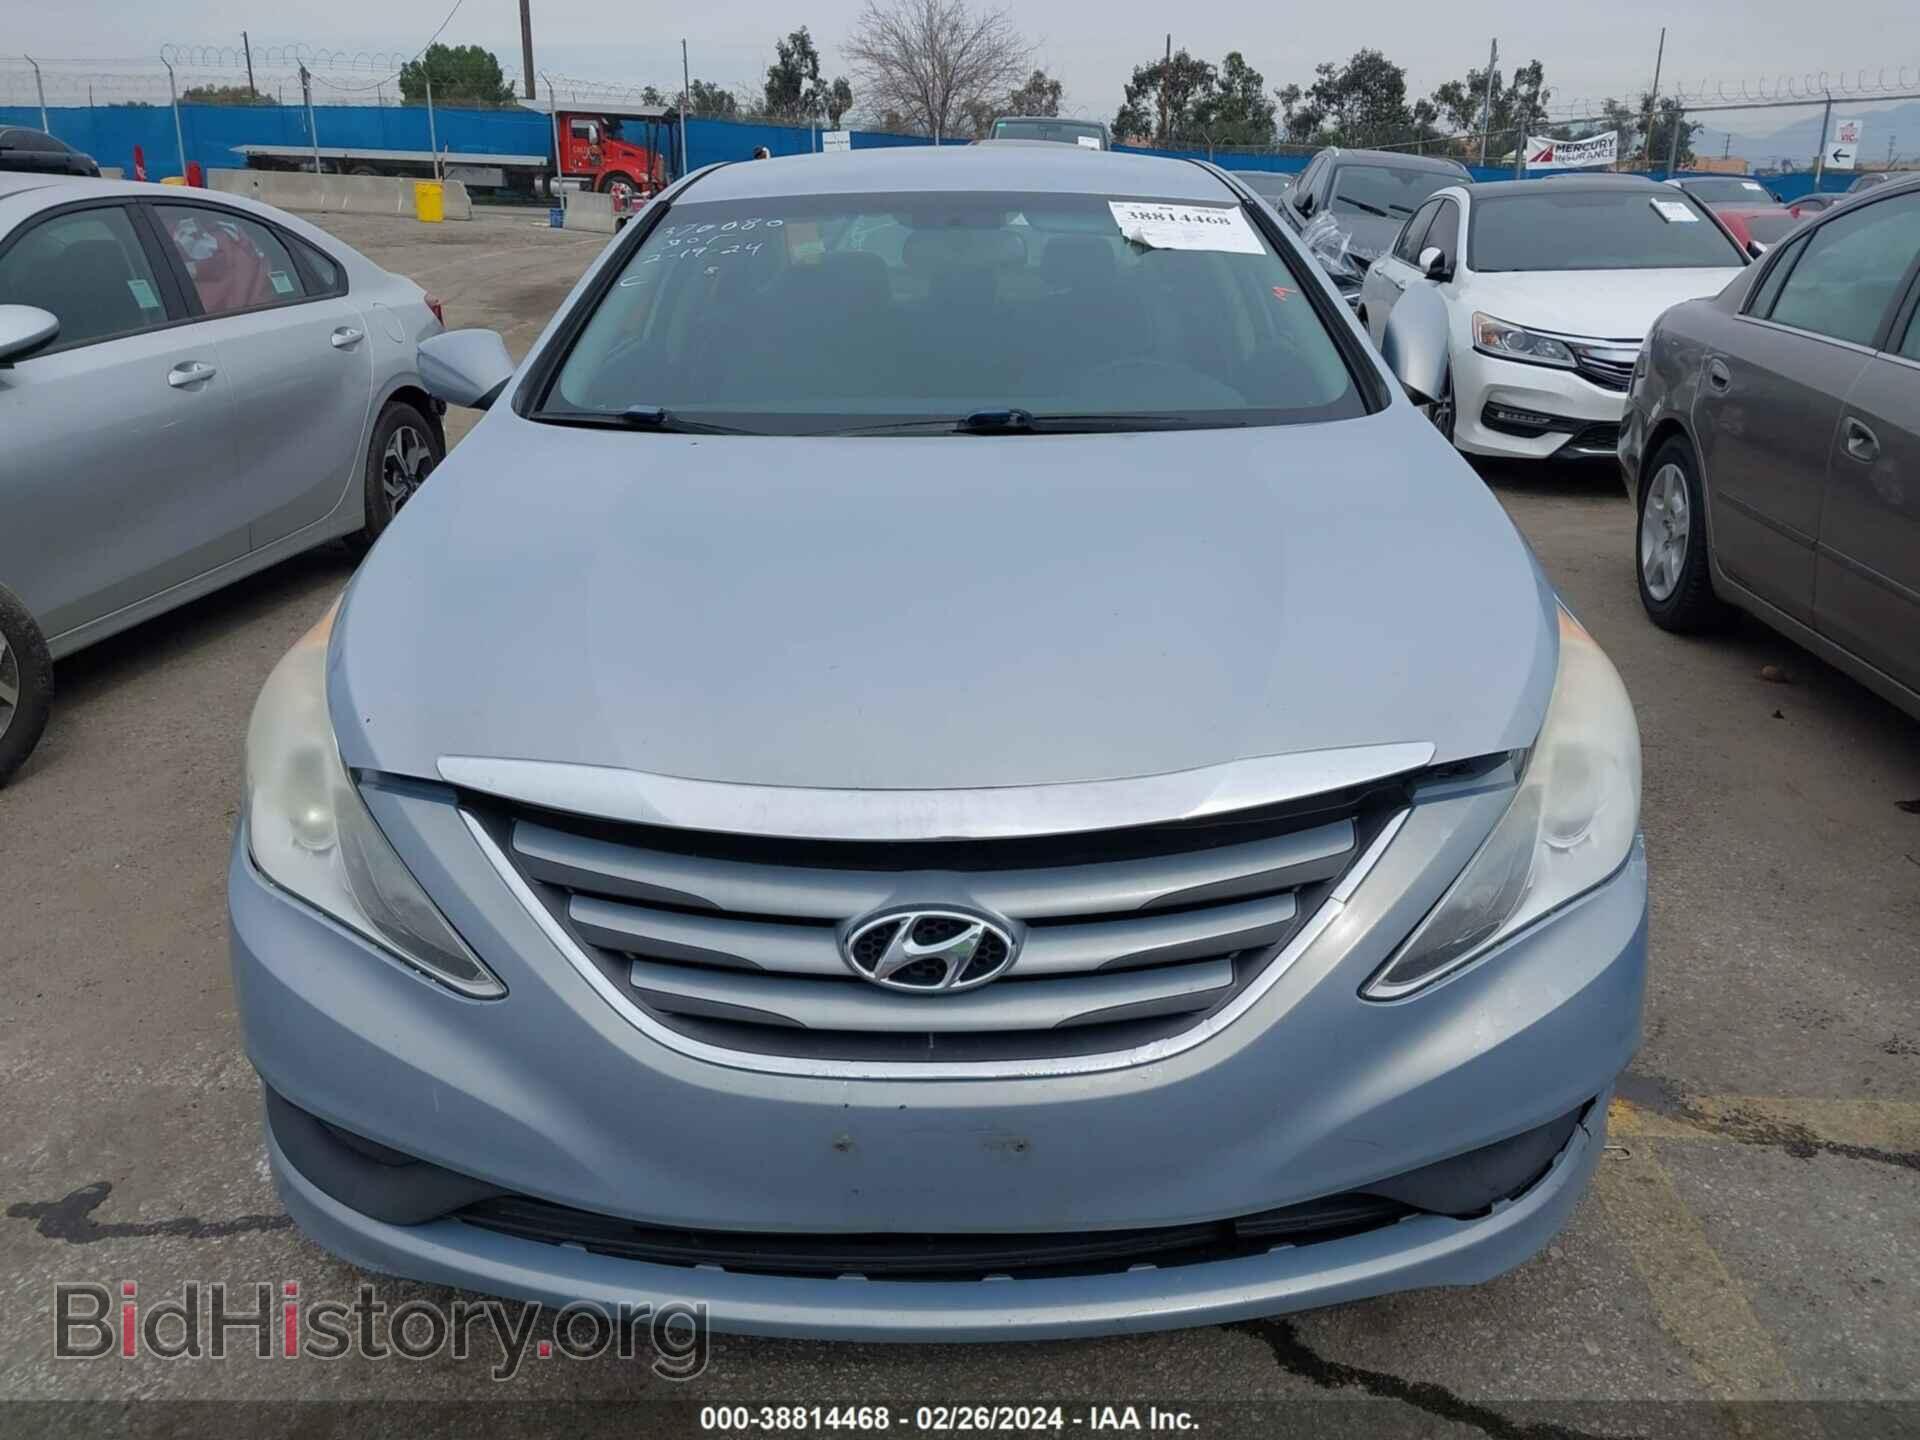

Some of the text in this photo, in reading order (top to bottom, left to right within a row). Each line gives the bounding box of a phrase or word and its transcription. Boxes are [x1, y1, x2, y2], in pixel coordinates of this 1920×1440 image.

[1555, 136, 1616, 154] MERCURY
[1554, 147, 1616, 162] INSURANCE
[1126, 210, 1232, 225] 38814468
